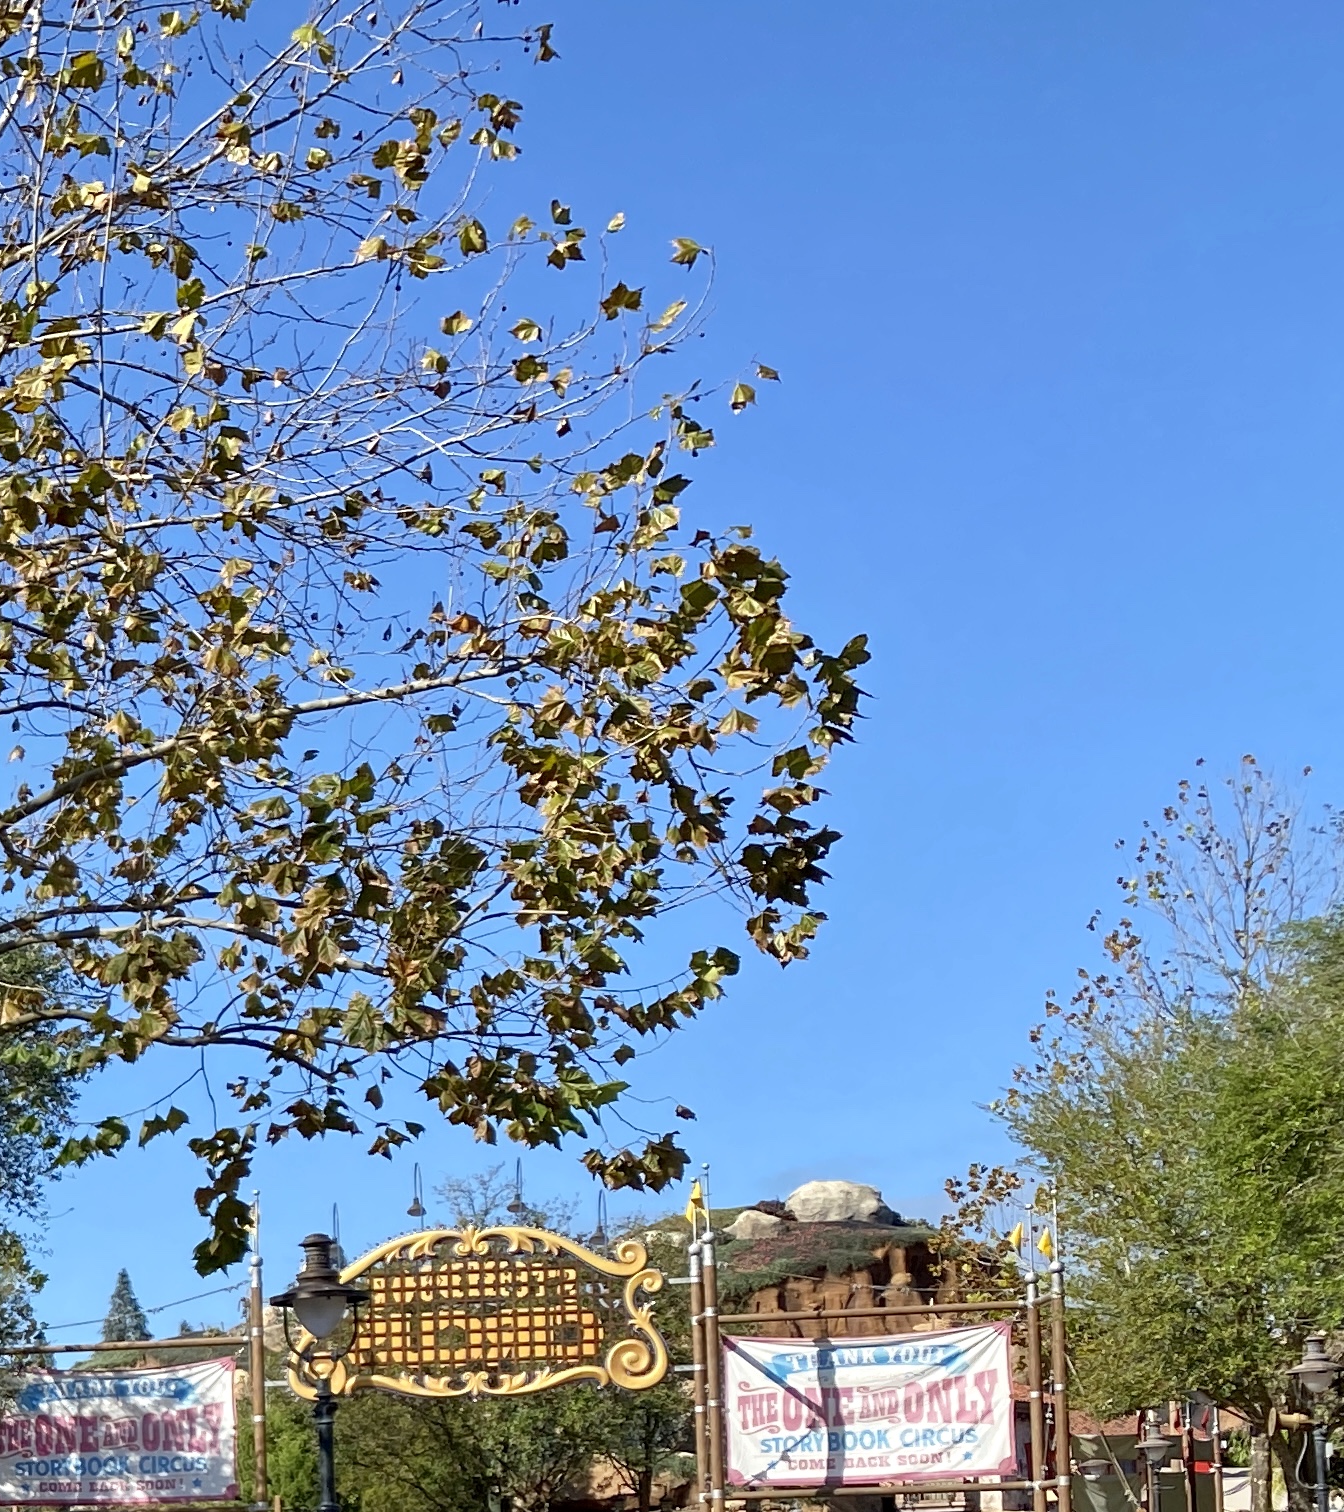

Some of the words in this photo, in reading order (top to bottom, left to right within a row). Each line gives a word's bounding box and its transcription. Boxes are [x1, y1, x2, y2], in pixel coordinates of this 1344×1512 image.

[785, 1347, 872, 1371] THANK
[737, 1392, 779, 1430] THE
[783, 1387, 855, 1431] ONE
[859, 1390, 899, 1419] AND
[904, 1369, 998, 1425] ONLY
[35, 1414, 99, 1456] ONE
[103, 1419, 138, 1447] AND
[142, 1402, 224, 1455] ONLY
[760, 1429, 890, 1453] STORYBOOK
[900, 1427, 979, 1448] CIRCUS
[15, 1456, 133, 1476] STORYBOOK
[138, 1456, 208, 1474] CIRCUS
[787, 1458, 836, 1471] COME
[844, 1455, 891, 1469] BACK
[897, 1451, 951, 1466] SOON!
[39, 1481, 82, 1493] COME
